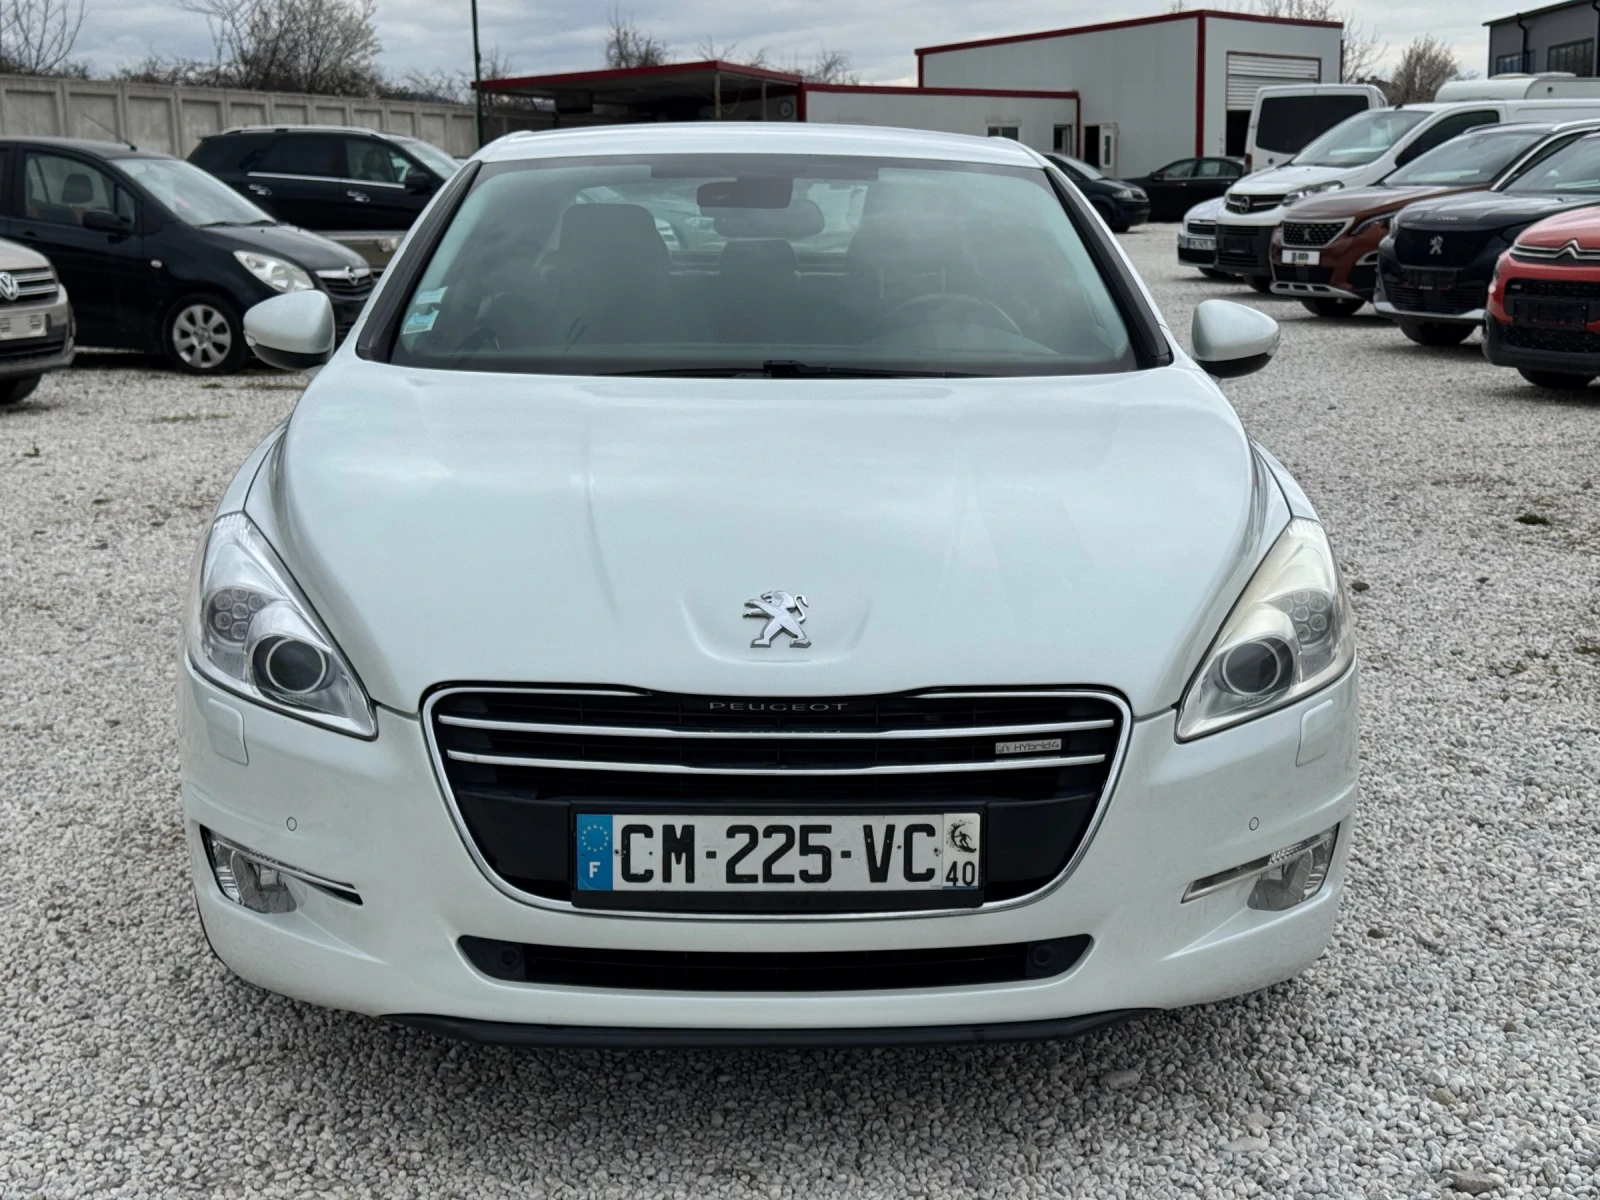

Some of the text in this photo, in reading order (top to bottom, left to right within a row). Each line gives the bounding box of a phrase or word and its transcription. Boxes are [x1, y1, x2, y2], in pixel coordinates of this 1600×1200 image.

[709, 702, 848, 711] PEUGEOT
[1014, 740, 1060, 752] HYbrid4
[621, 824, 936, 883] CM-225-VC
[589, 861, 601, 878] F
[945, 861, 975, 886] 40
